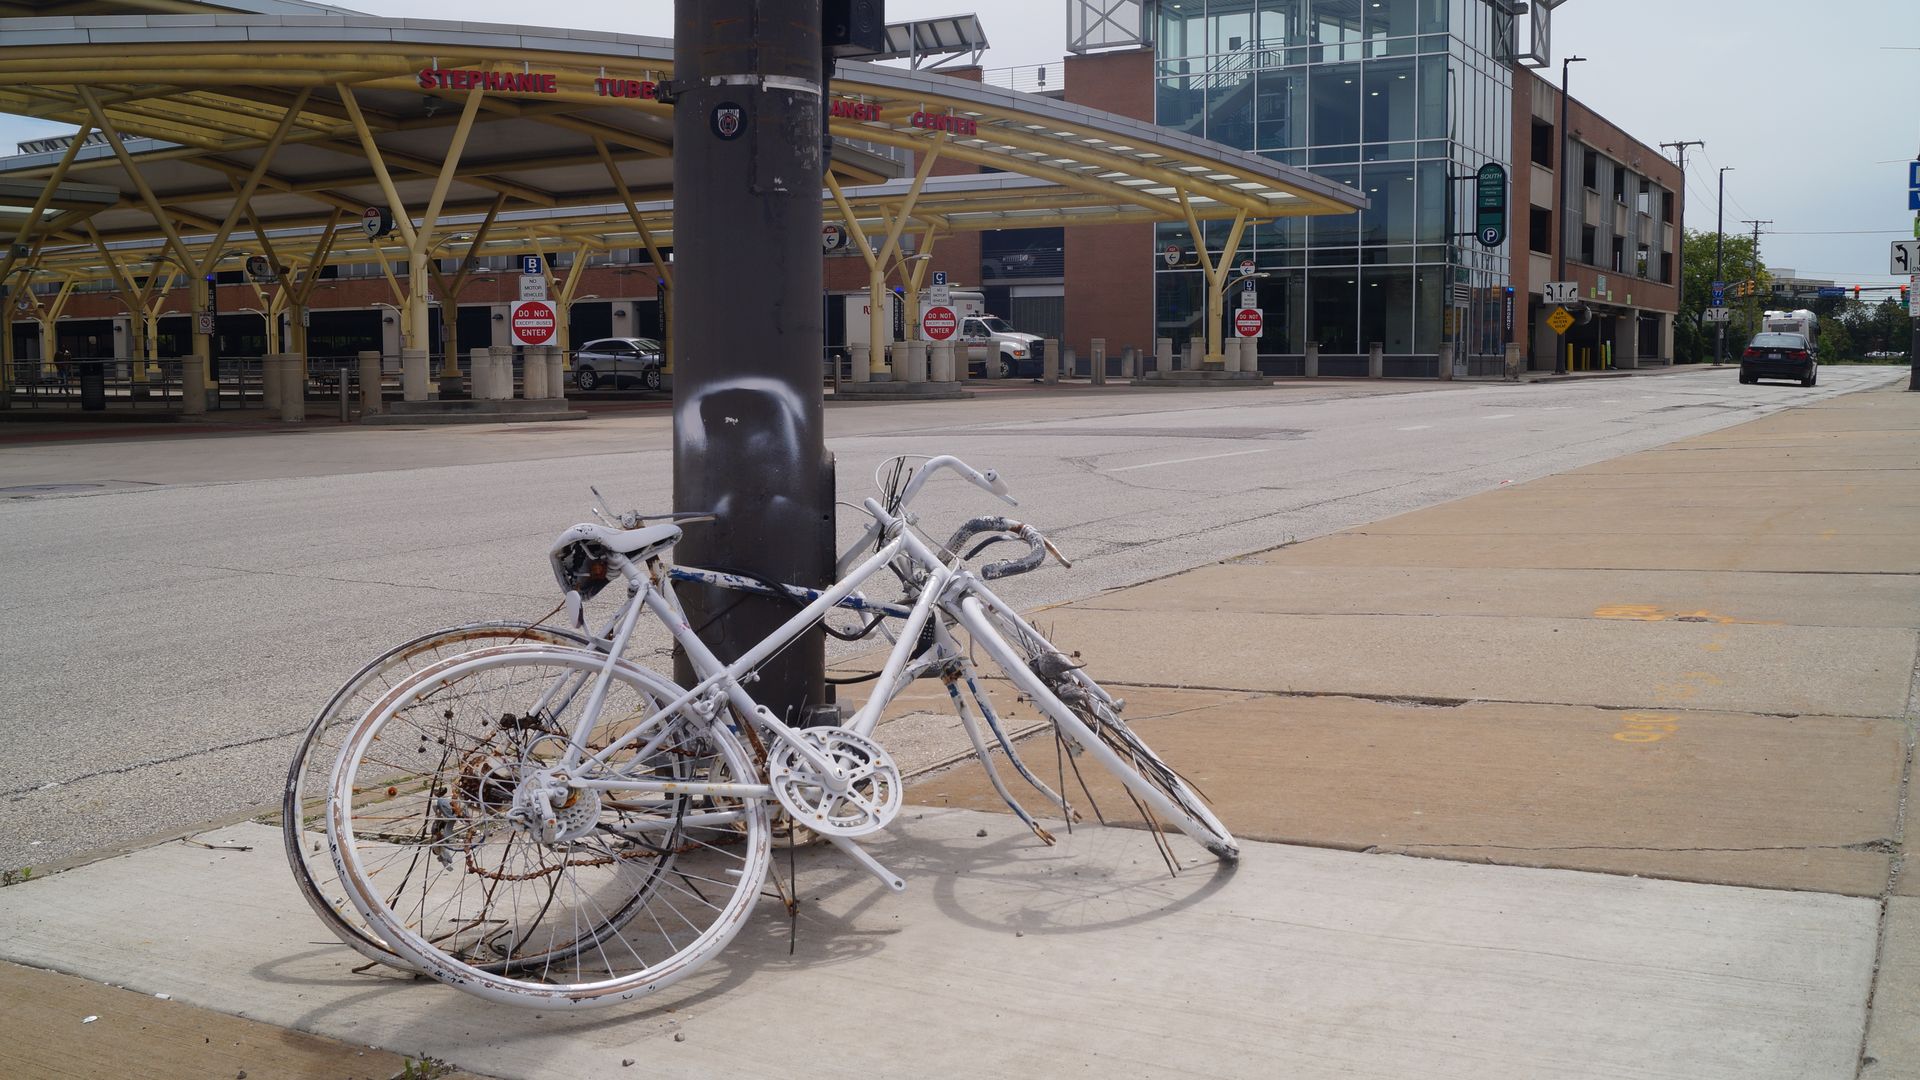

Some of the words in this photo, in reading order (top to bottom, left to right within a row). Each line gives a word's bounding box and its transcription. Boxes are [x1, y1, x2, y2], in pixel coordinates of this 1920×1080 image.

[418, 68, 557, 93] STEPHANIE
[912, 111, 977, 136] CENTER
[1486, 230, 1496, 241] P
[528, 258, 537, 269] B
[935, 272, 944, 281] C
[518, 309, 530, 317] DO
[534, 309, 550, 317] NOT
[521, 328, 547, 337] ENTER
